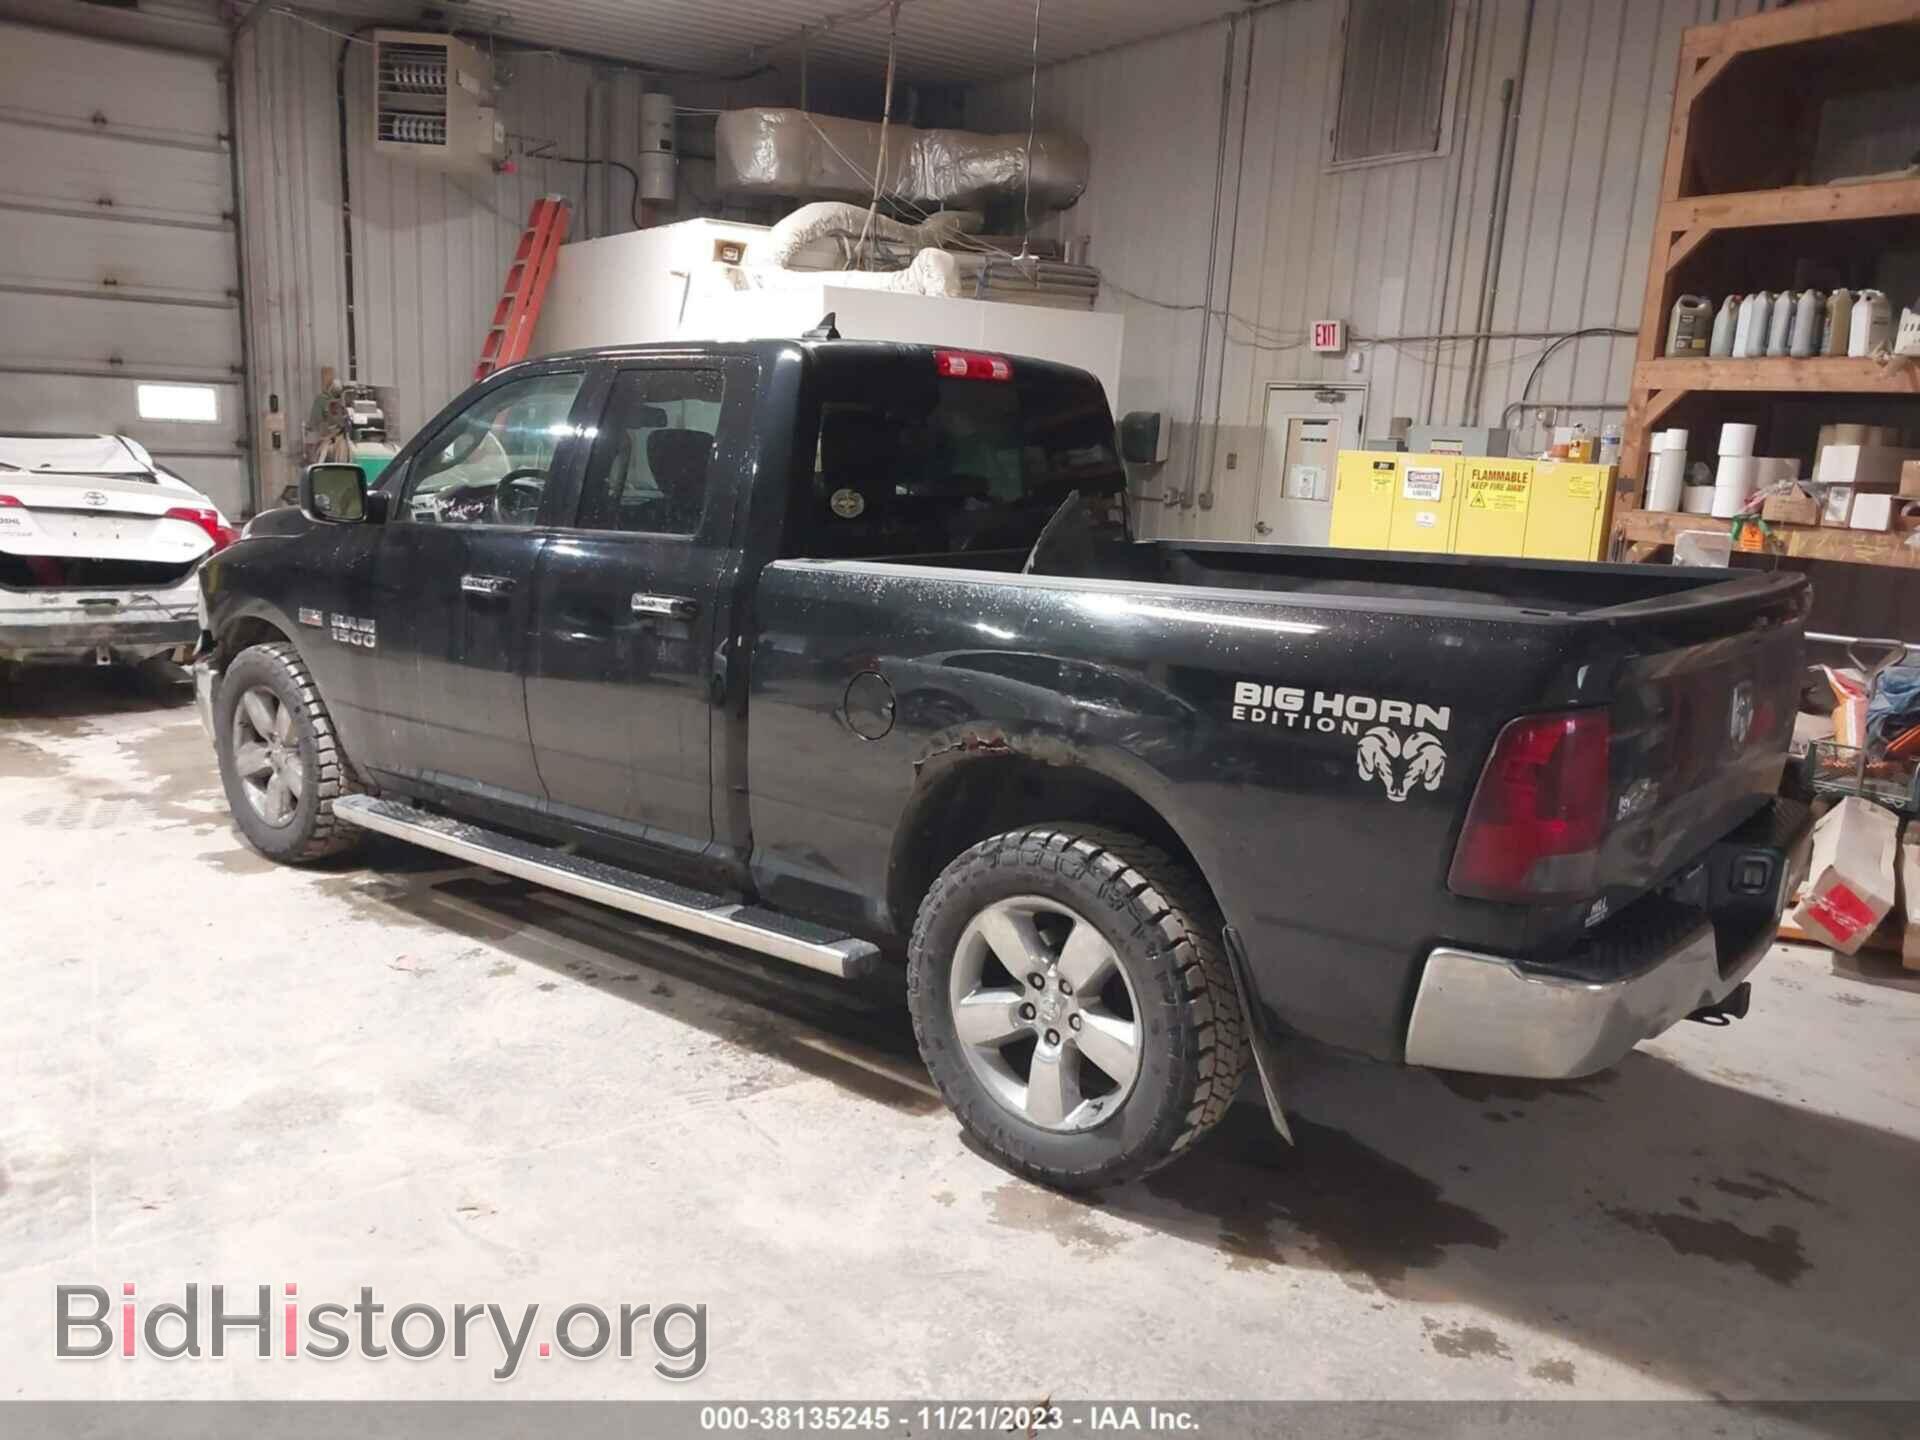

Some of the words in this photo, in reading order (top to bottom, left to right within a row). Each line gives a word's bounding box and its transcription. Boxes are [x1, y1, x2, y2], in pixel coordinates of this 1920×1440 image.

[1315, 323, 1336, 346] EXIT
[1471, 481, 1488, 490] KEEP
[1472, 469, 1528, 484] FLAMMABLE
[331, 627, 376, 649] 1500
[1234, 681, 1305, 711] BIG
[1312, 691, 1451, 731] HORN
[1232, 705, 1359, 736] EDITION
